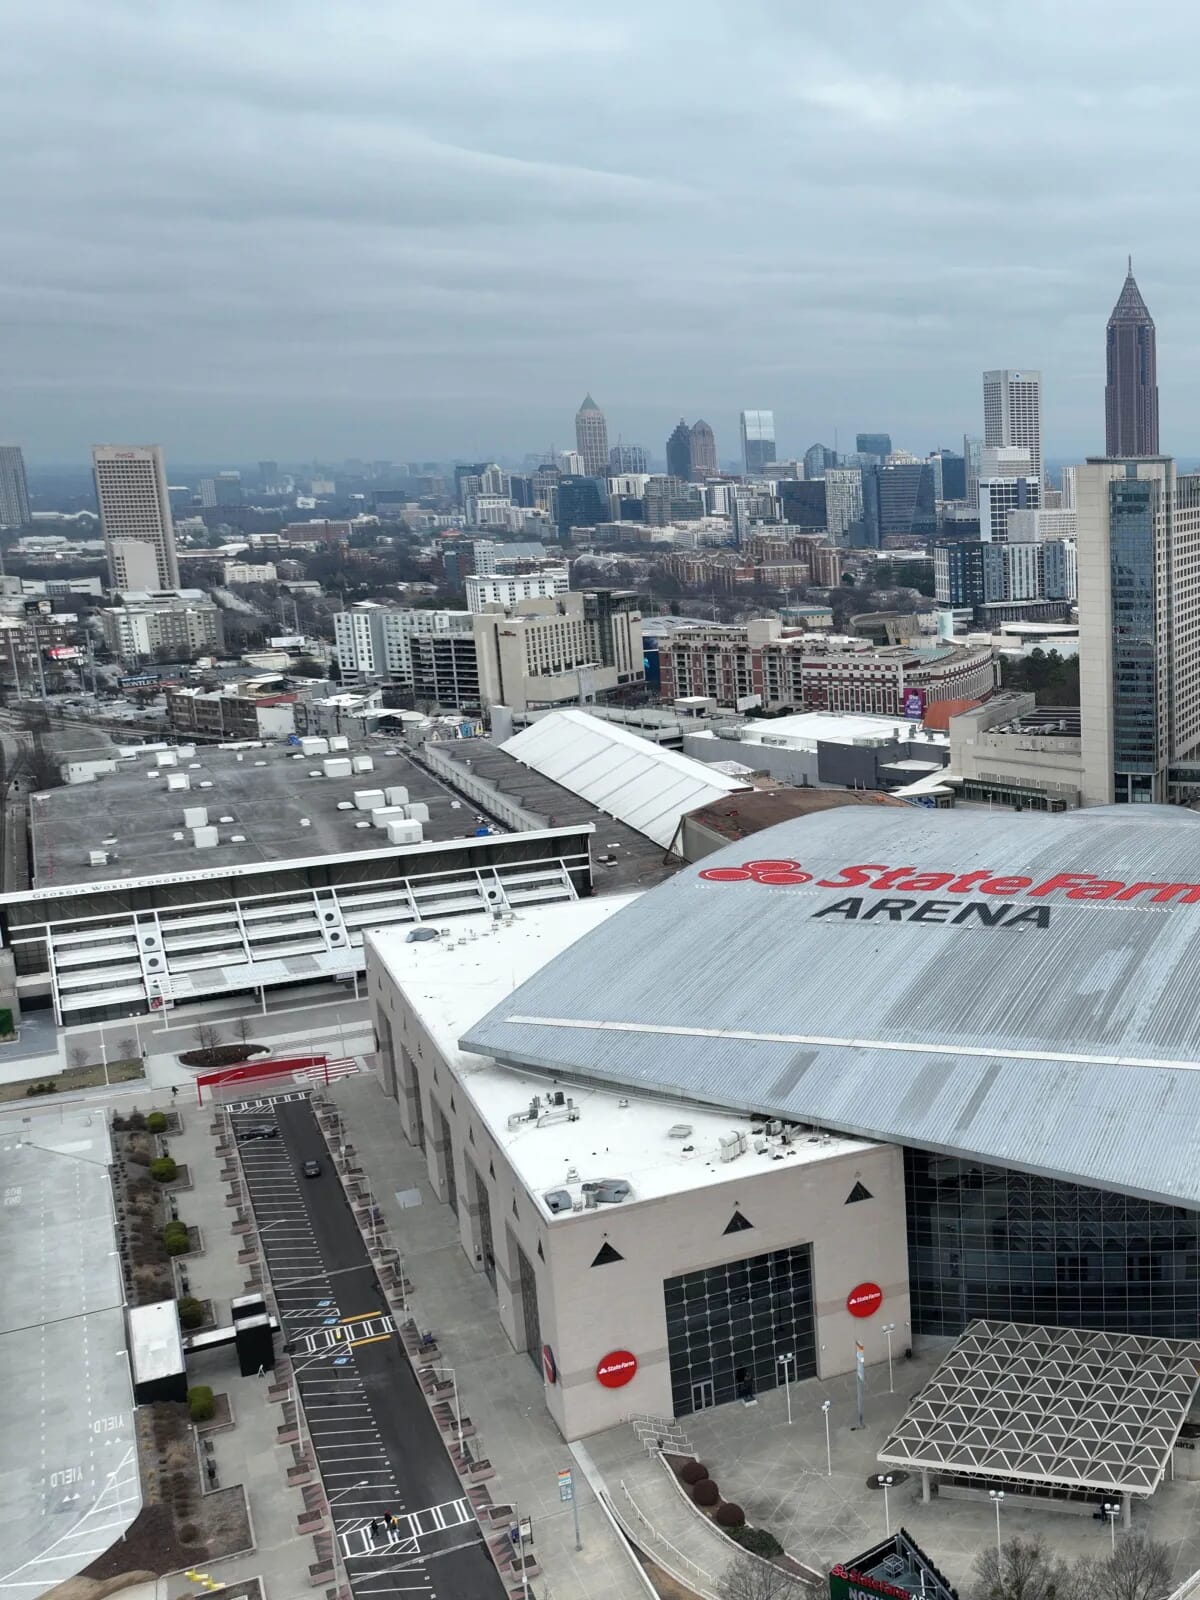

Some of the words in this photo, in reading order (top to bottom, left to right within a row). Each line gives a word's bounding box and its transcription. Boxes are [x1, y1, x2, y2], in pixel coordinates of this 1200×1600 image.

[811, 897, 1050, 928] ARENA
[94, 1414, 125, 1433] YIELD
[50, 1466, 83, 1488] YIELD
